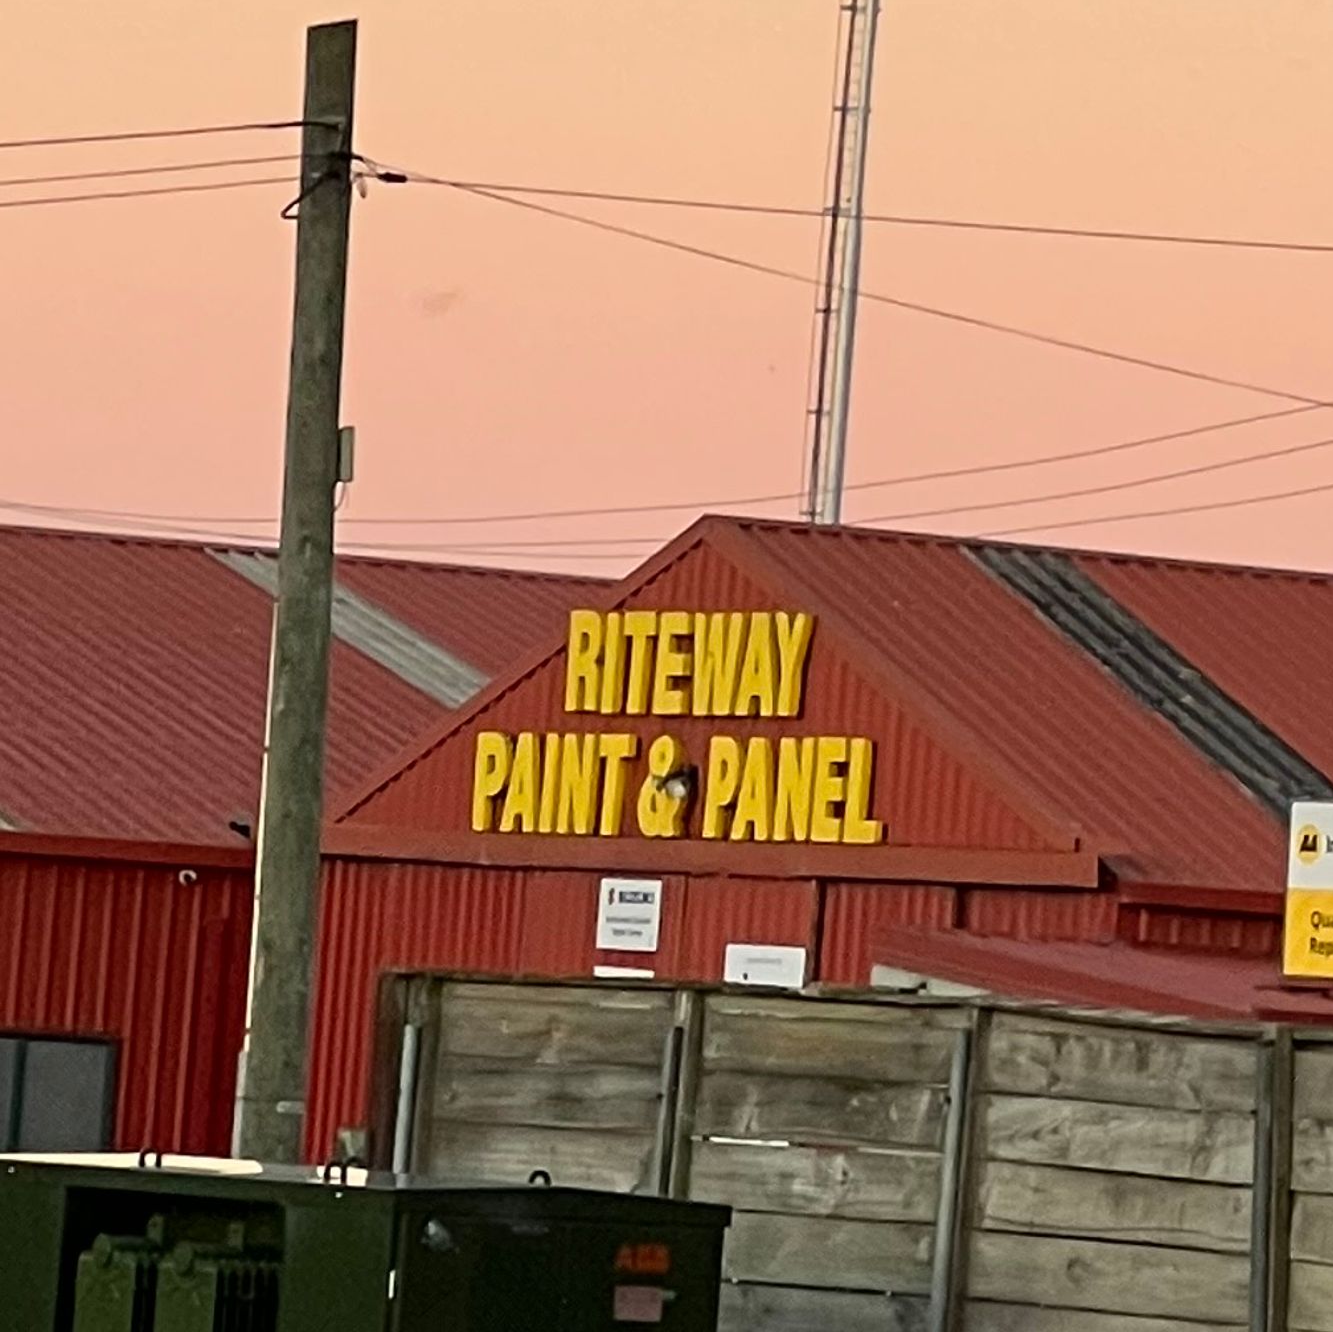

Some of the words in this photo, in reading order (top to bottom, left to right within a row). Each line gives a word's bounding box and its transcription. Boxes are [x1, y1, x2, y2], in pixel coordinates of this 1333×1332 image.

[565, 610, 814, 717] RITEWAY
[472, 731, 637, 837] PAINT
[636, 734, 686, 838] &
[701, 735, 884, 844] PANEL
